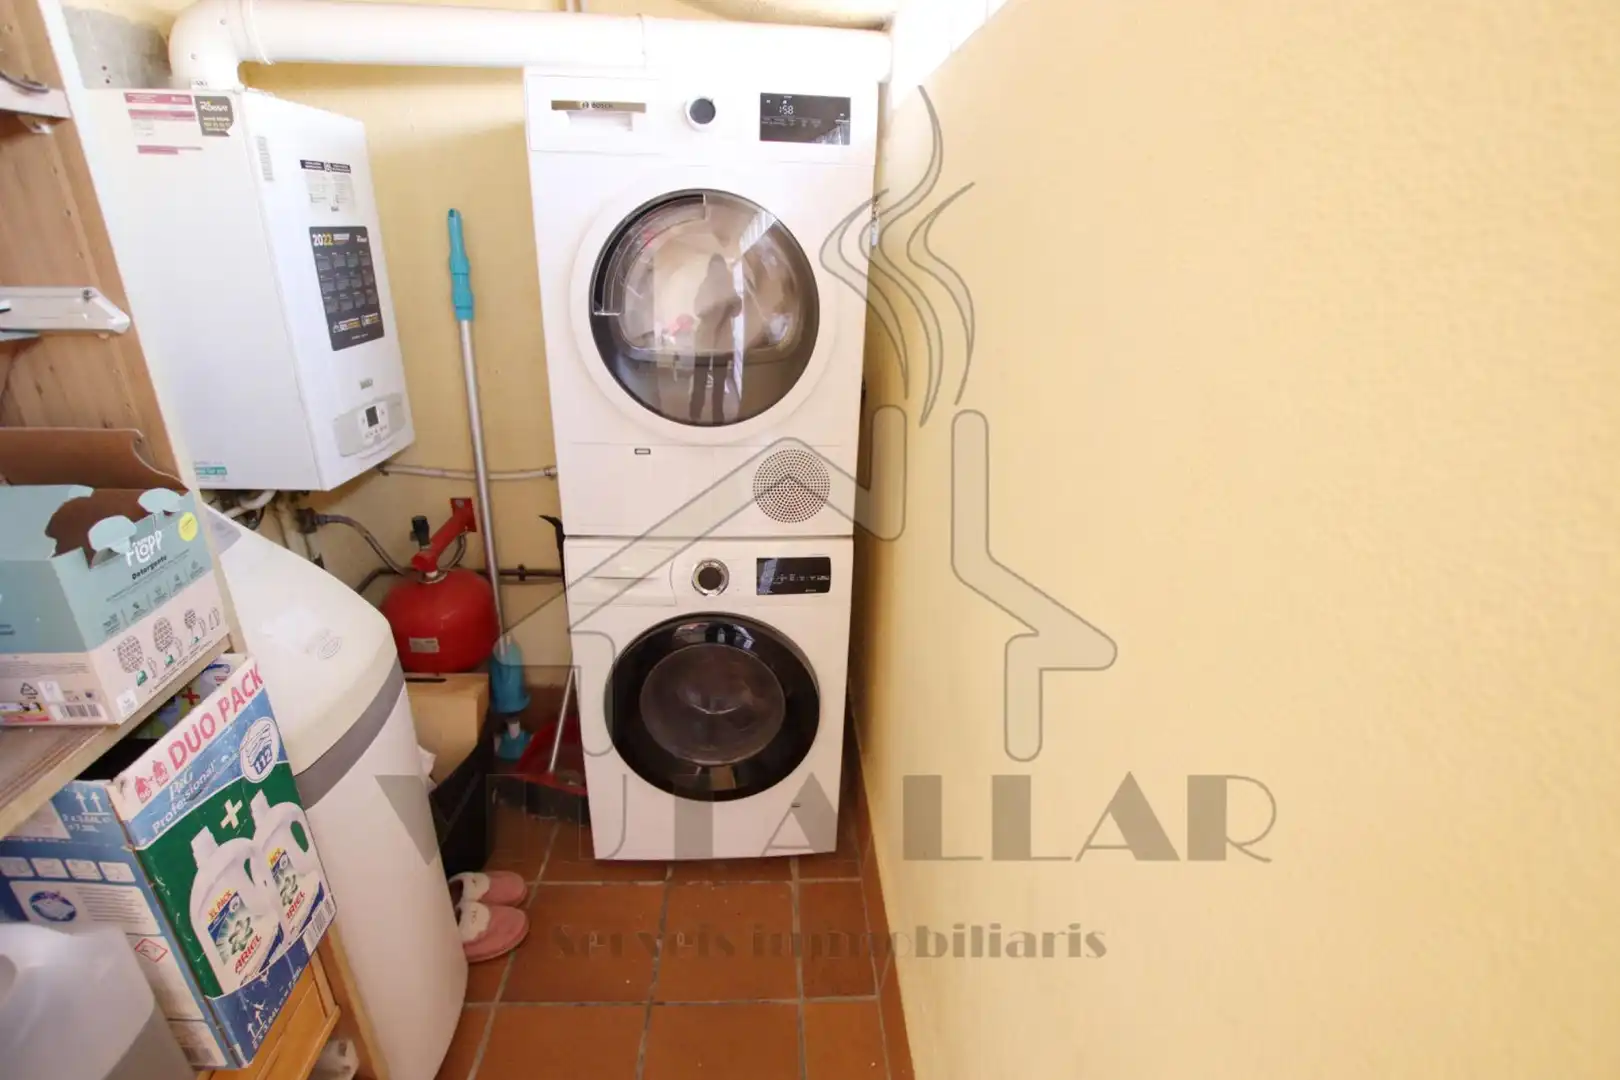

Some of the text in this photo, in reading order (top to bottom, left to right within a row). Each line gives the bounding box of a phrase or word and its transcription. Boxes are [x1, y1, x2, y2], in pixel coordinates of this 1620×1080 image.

[312, 233, 334, 247] 2022
[167, 711, 217, 771] DUO
[216, 663, 264, 723] PACK
[254, 746, 273, 775] 112
[234, 933, 262, 975] ARIEL
